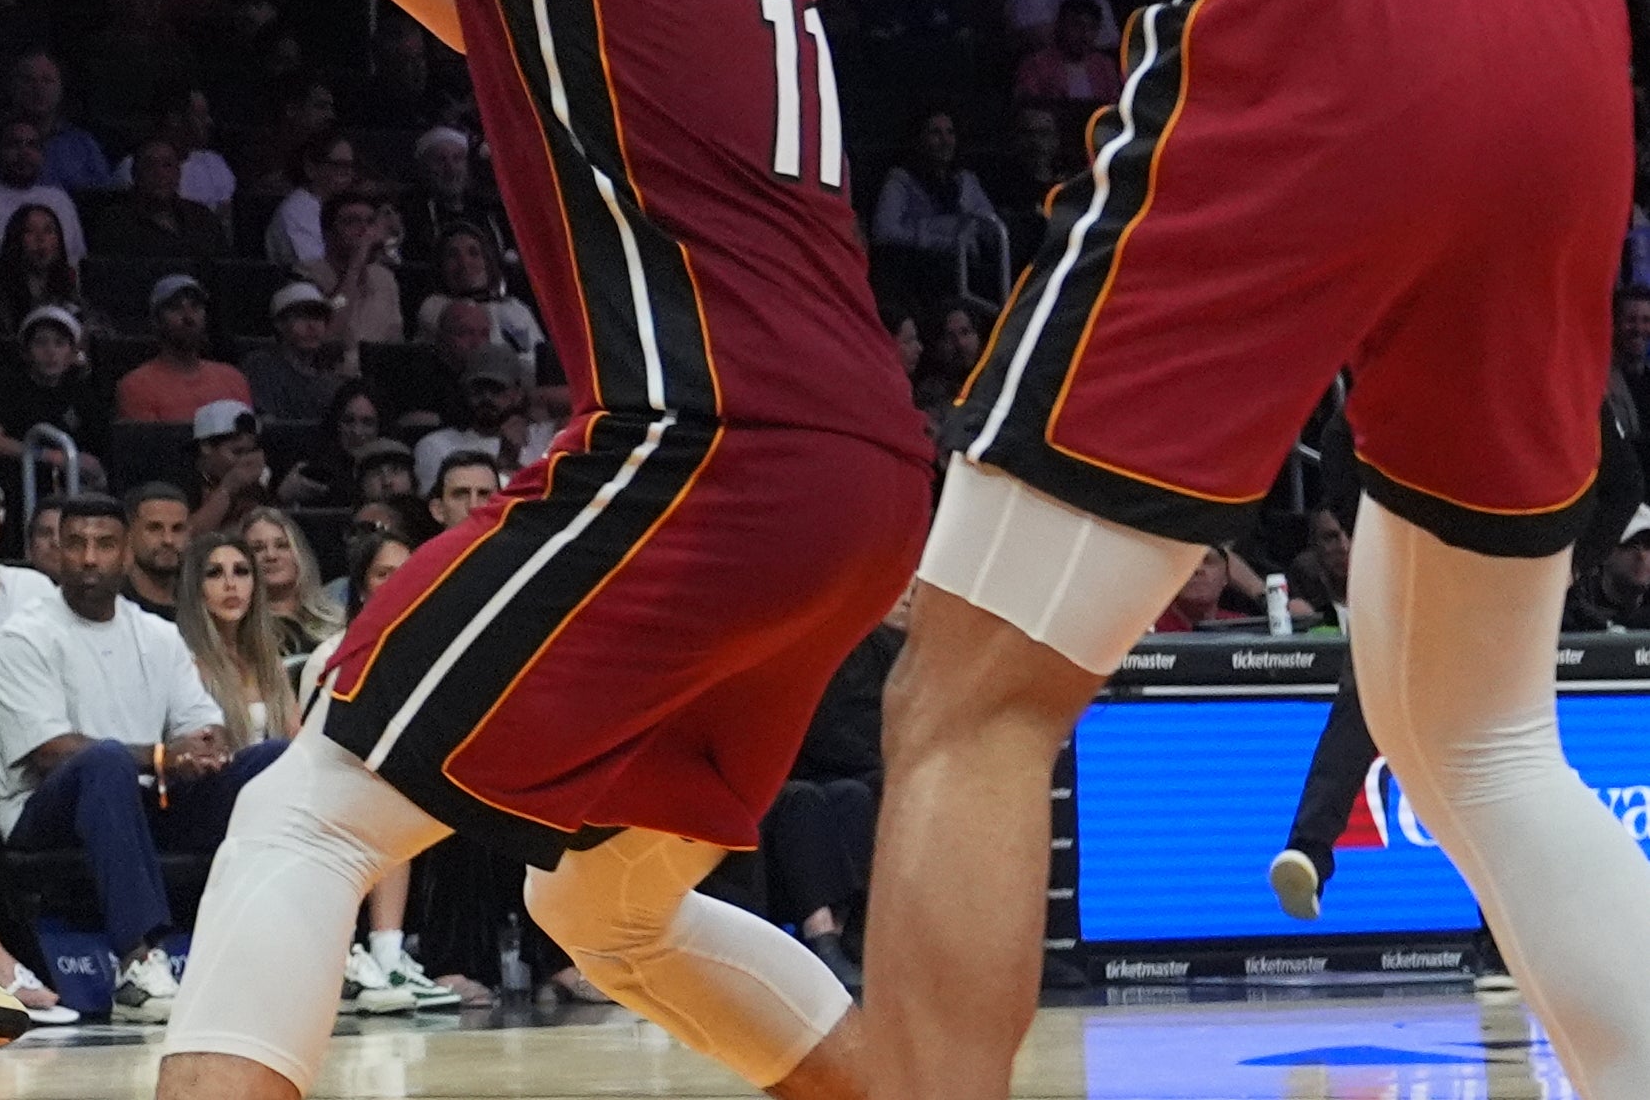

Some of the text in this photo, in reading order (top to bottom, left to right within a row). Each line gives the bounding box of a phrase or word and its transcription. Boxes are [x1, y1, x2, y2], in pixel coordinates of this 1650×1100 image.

[1120, 650, 1317, 670] tmaster ticketmaster
[1105, 950, 1463, 980] ticketmaster ticketmaster ticketmaster
